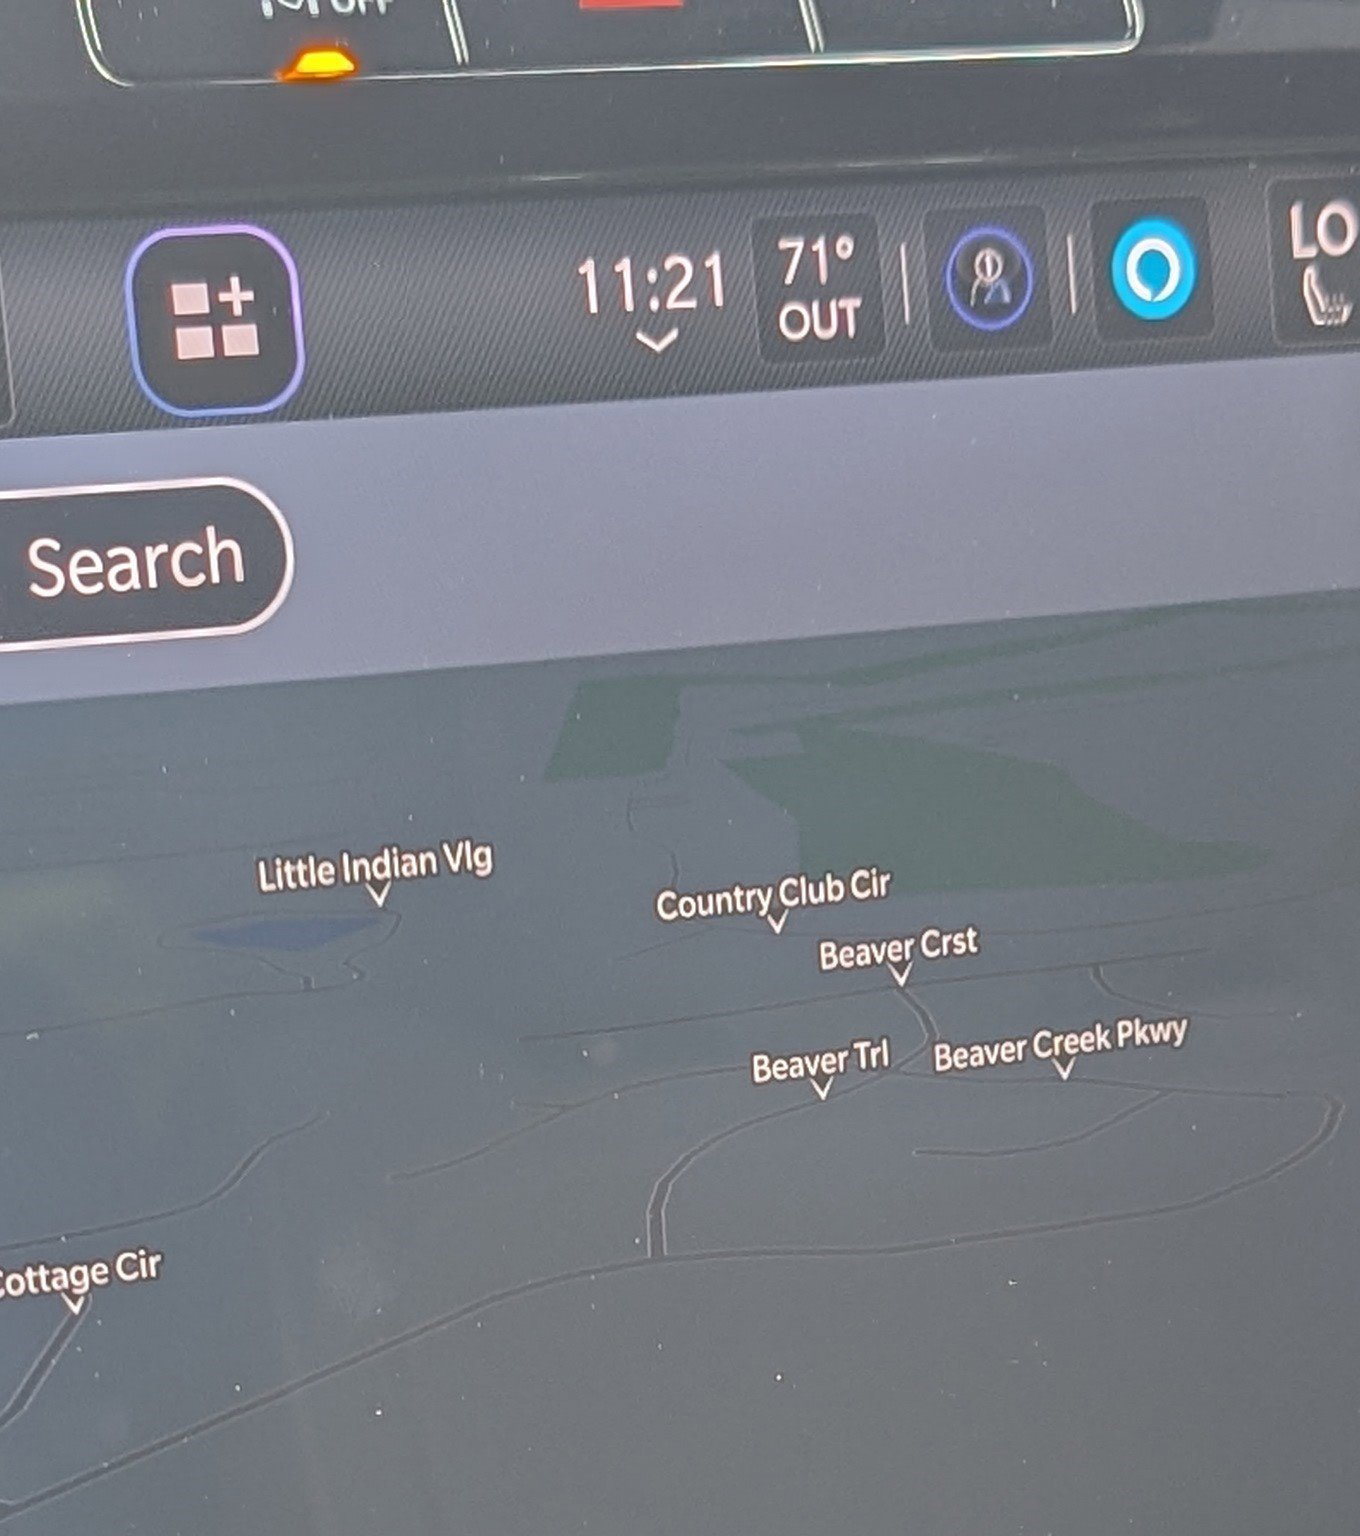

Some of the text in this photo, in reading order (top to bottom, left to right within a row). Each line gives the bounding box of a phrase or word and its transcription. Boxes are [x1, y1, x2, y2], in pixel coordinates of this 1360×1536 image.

[1290, 202, 1358, 259] LO
[578, 250, 724, 314] 11:21
[778, 235, 854, 285] 71°
[779, 297, 862, 341] OUT
[28, 525, 245, 598] Search
[258, 840, 493, 892] Little Indian Vlg
[657, 869, 891, 923] Country Club Cir
[820, 927, 978, 973] Beaver Crst
[753, 1038, 889, 1083] Beaver Trl
[934, 1017, 1188, 1072] Beaver Creek Pkwy
[115, 1249, 162, 1281] Cir
